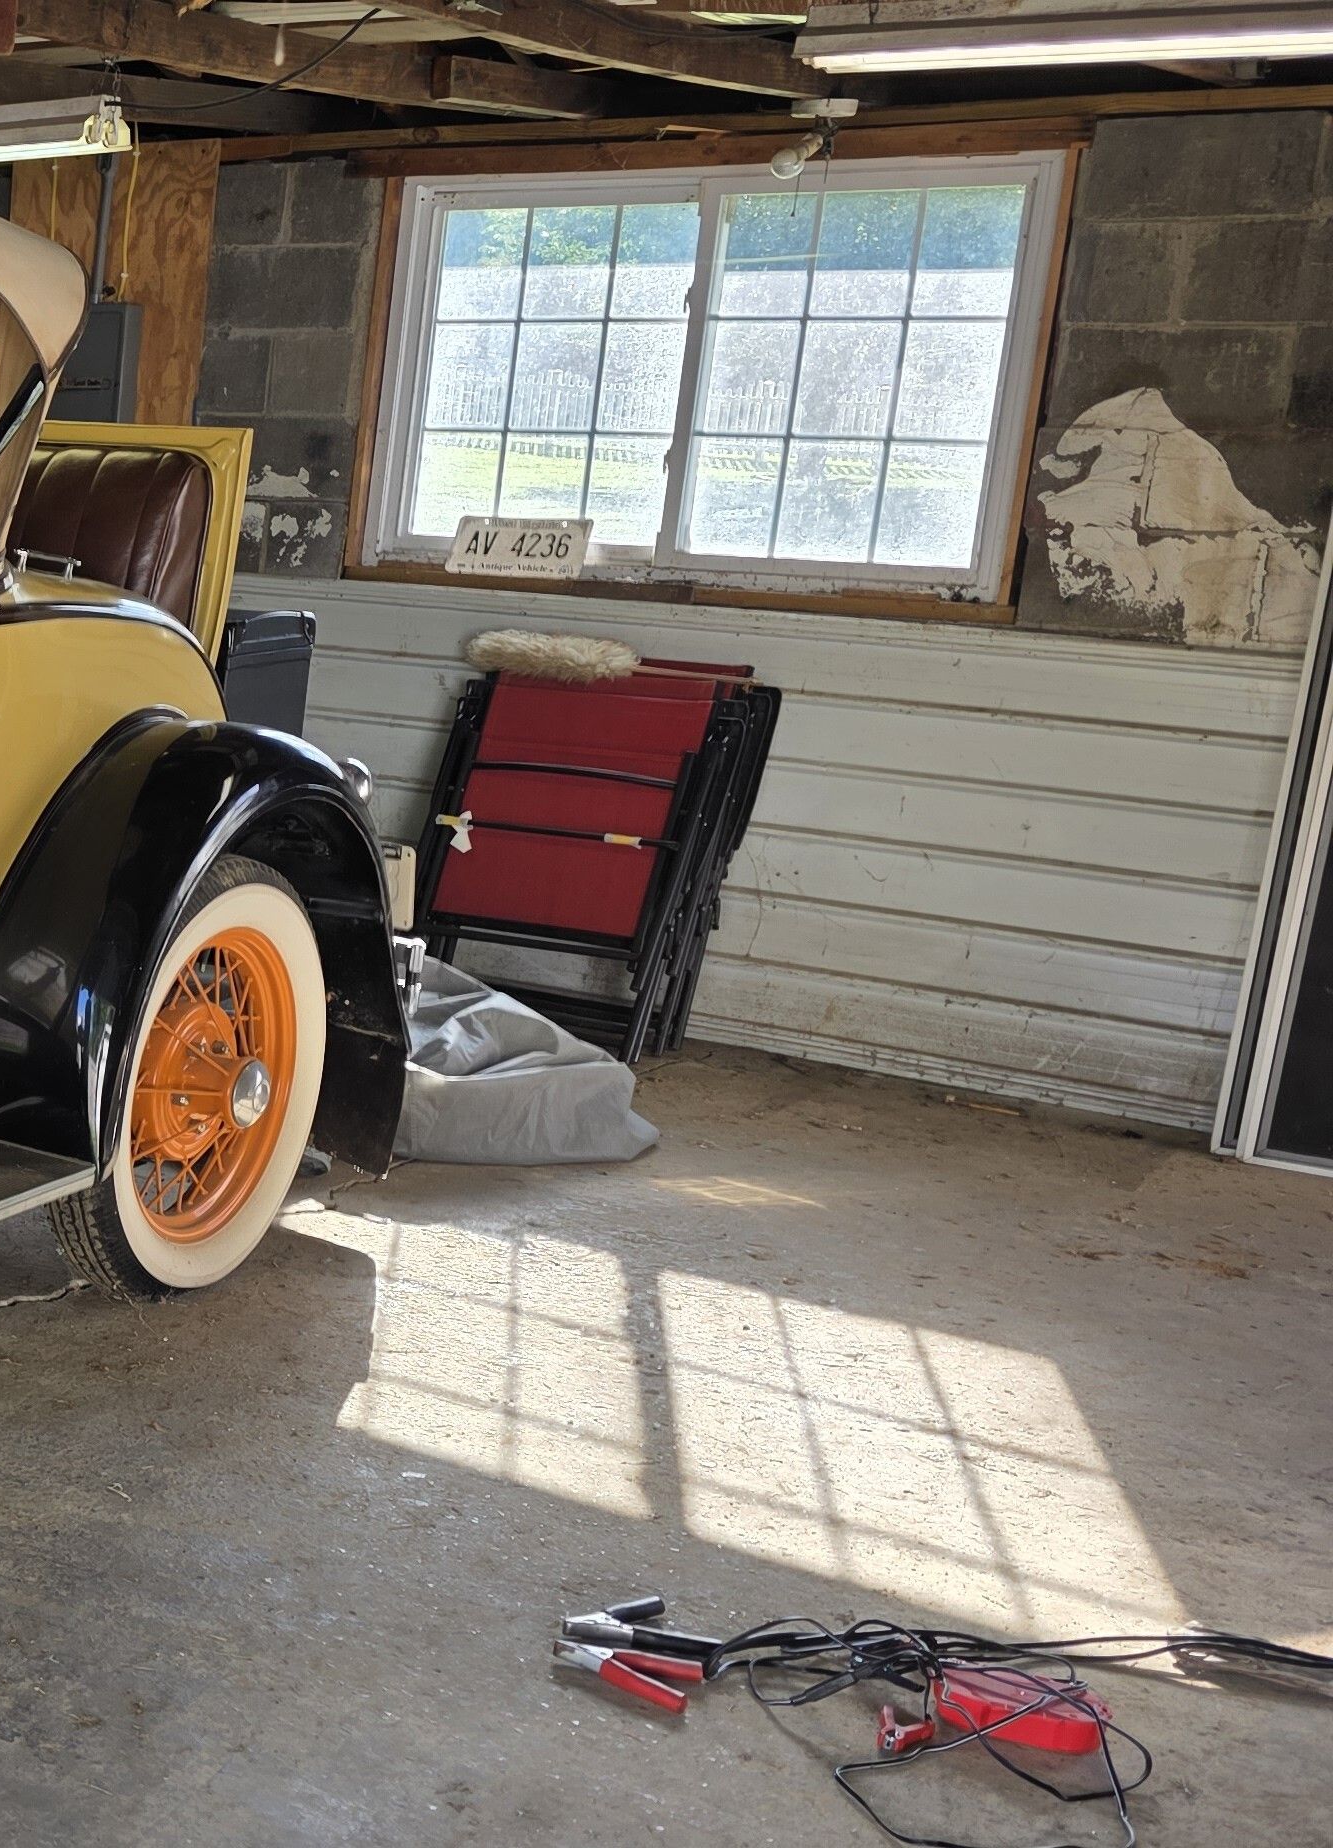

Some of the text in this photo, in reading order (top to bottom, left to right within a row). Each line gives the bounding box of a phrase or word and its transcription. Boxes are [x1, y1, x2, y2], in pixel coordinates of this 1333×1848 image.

[465, 530, 572, 559] AV 4236
[479, 562, 514, 574] Antique
[517, 563, 548, 574] Vehicle
